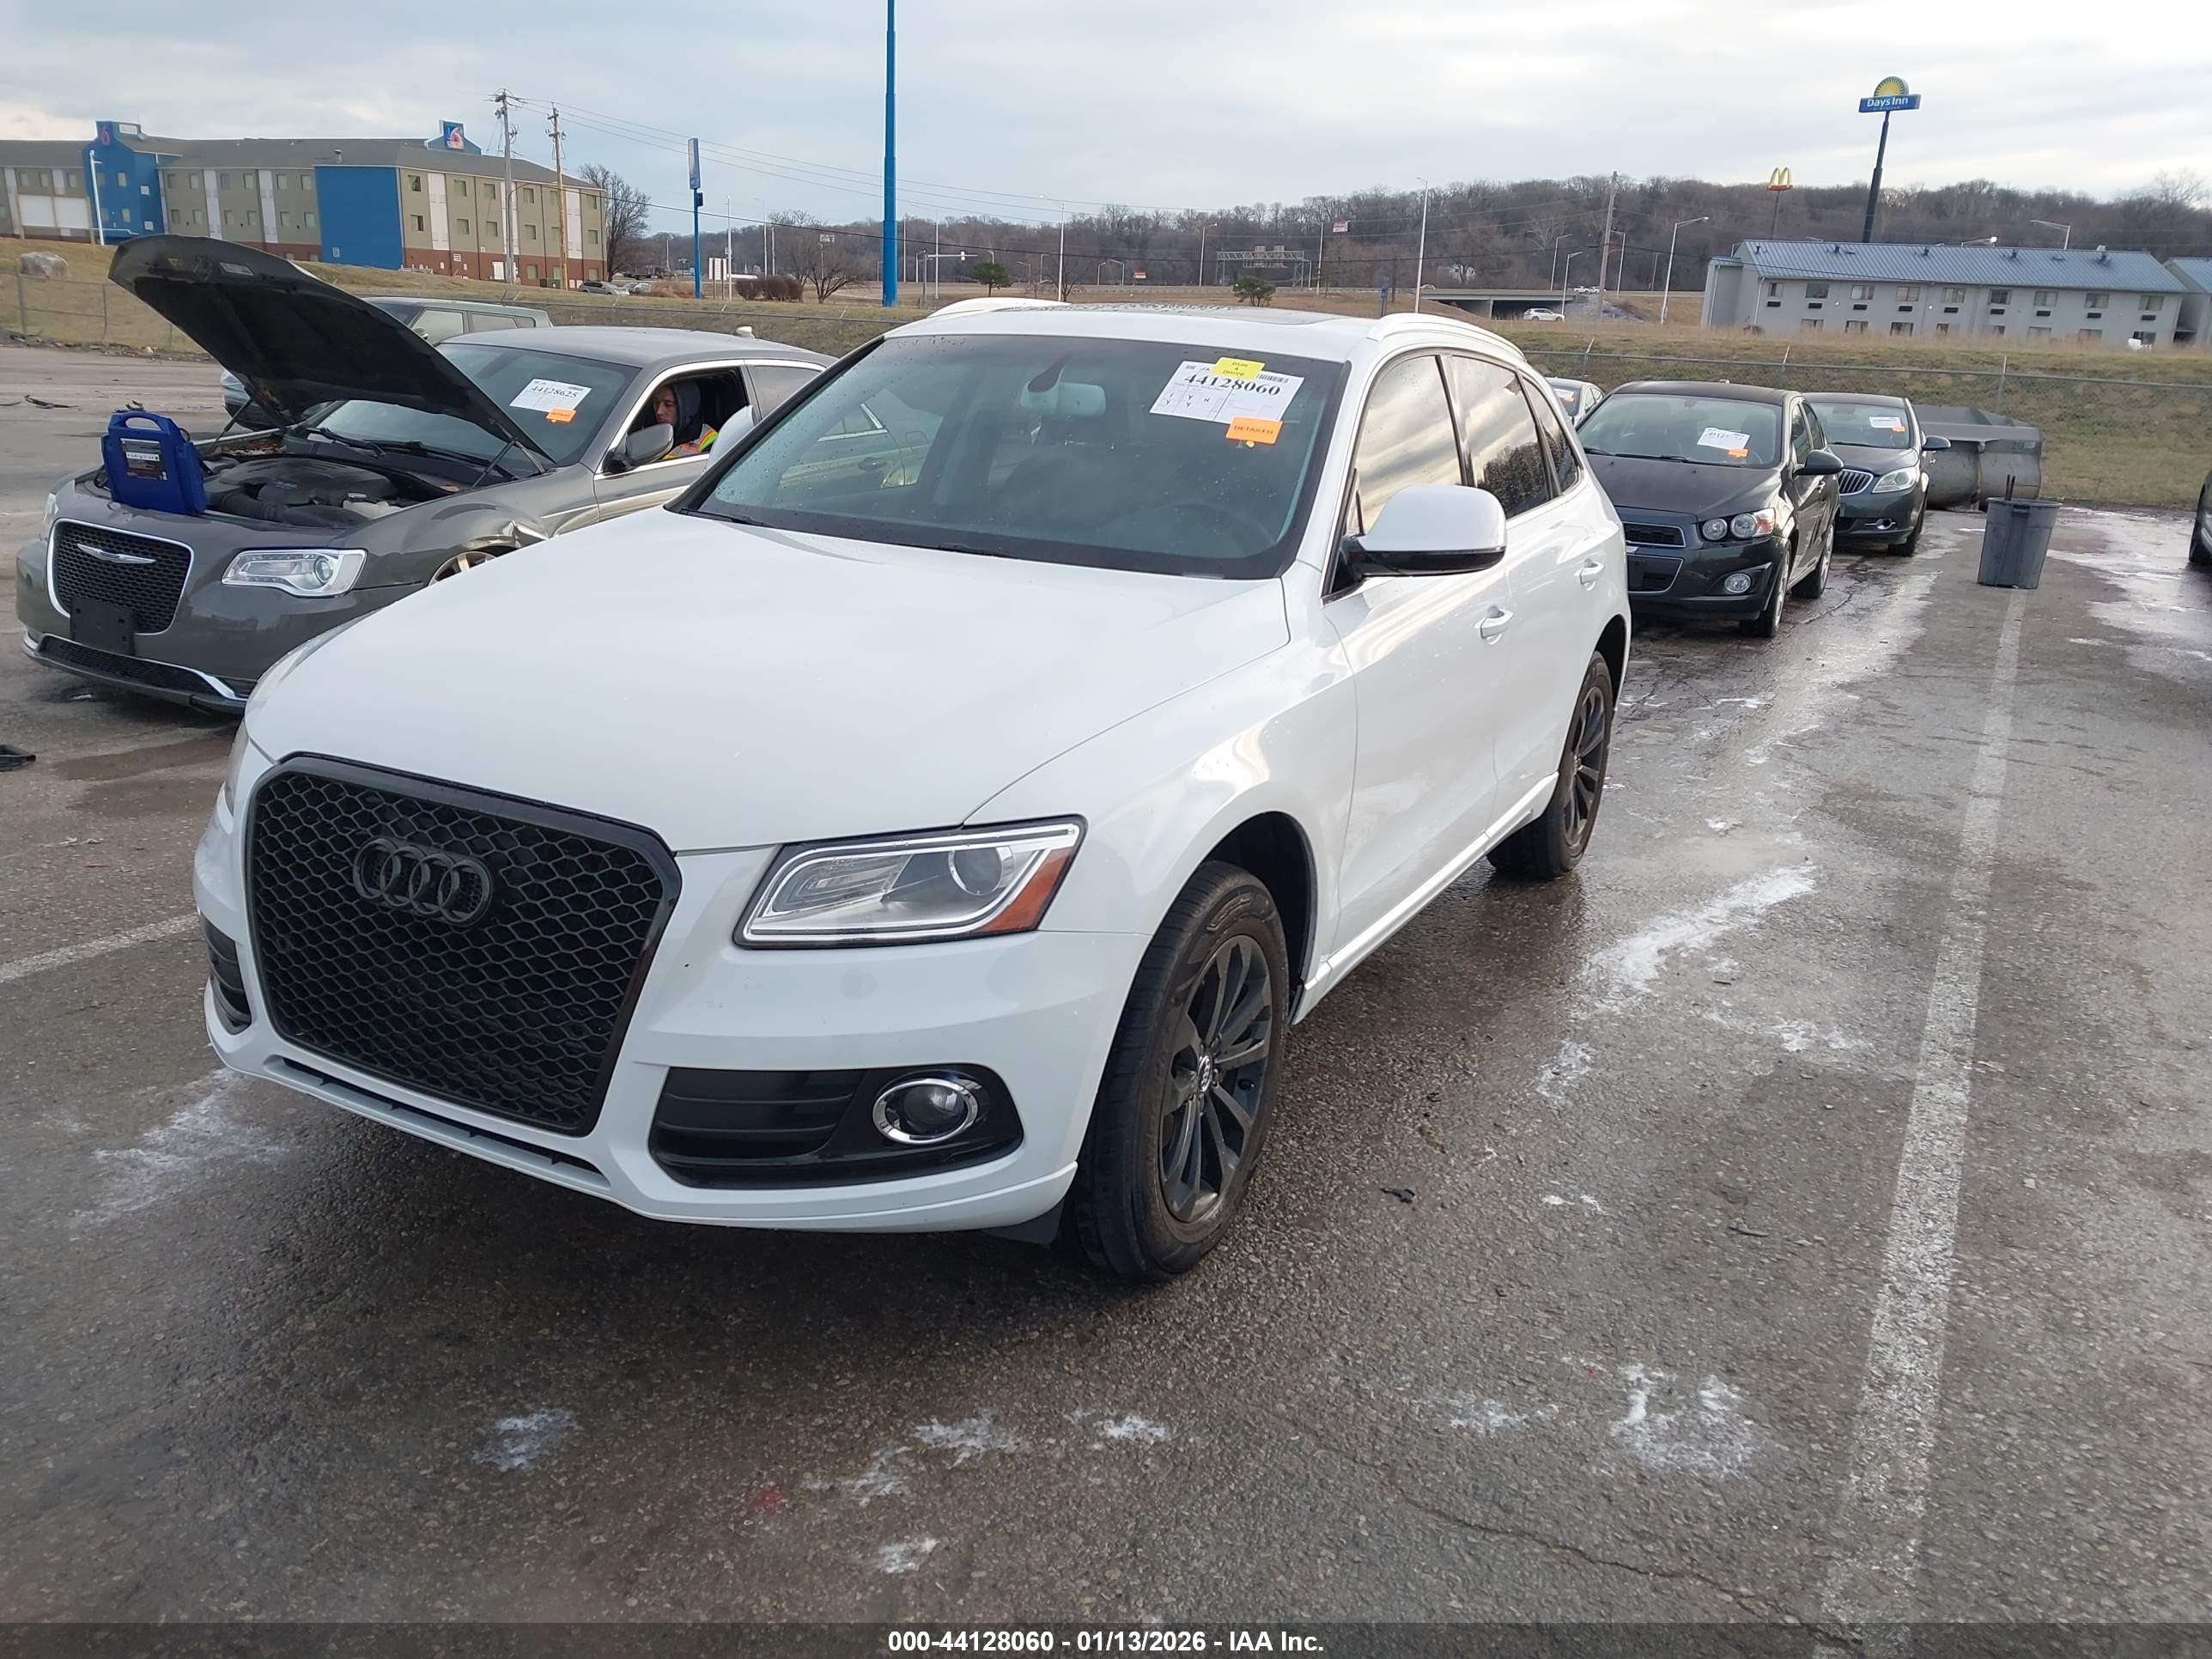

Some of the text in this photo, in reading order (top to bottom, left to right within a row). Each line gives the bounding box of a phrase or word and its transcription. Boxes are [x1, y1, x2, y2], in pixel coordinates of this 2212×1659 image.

[1867, 97, 1908, 107] Days Inn
[531, 385, 578, 398] 44128625
[1184, 374, 1280, 396] 44128060
